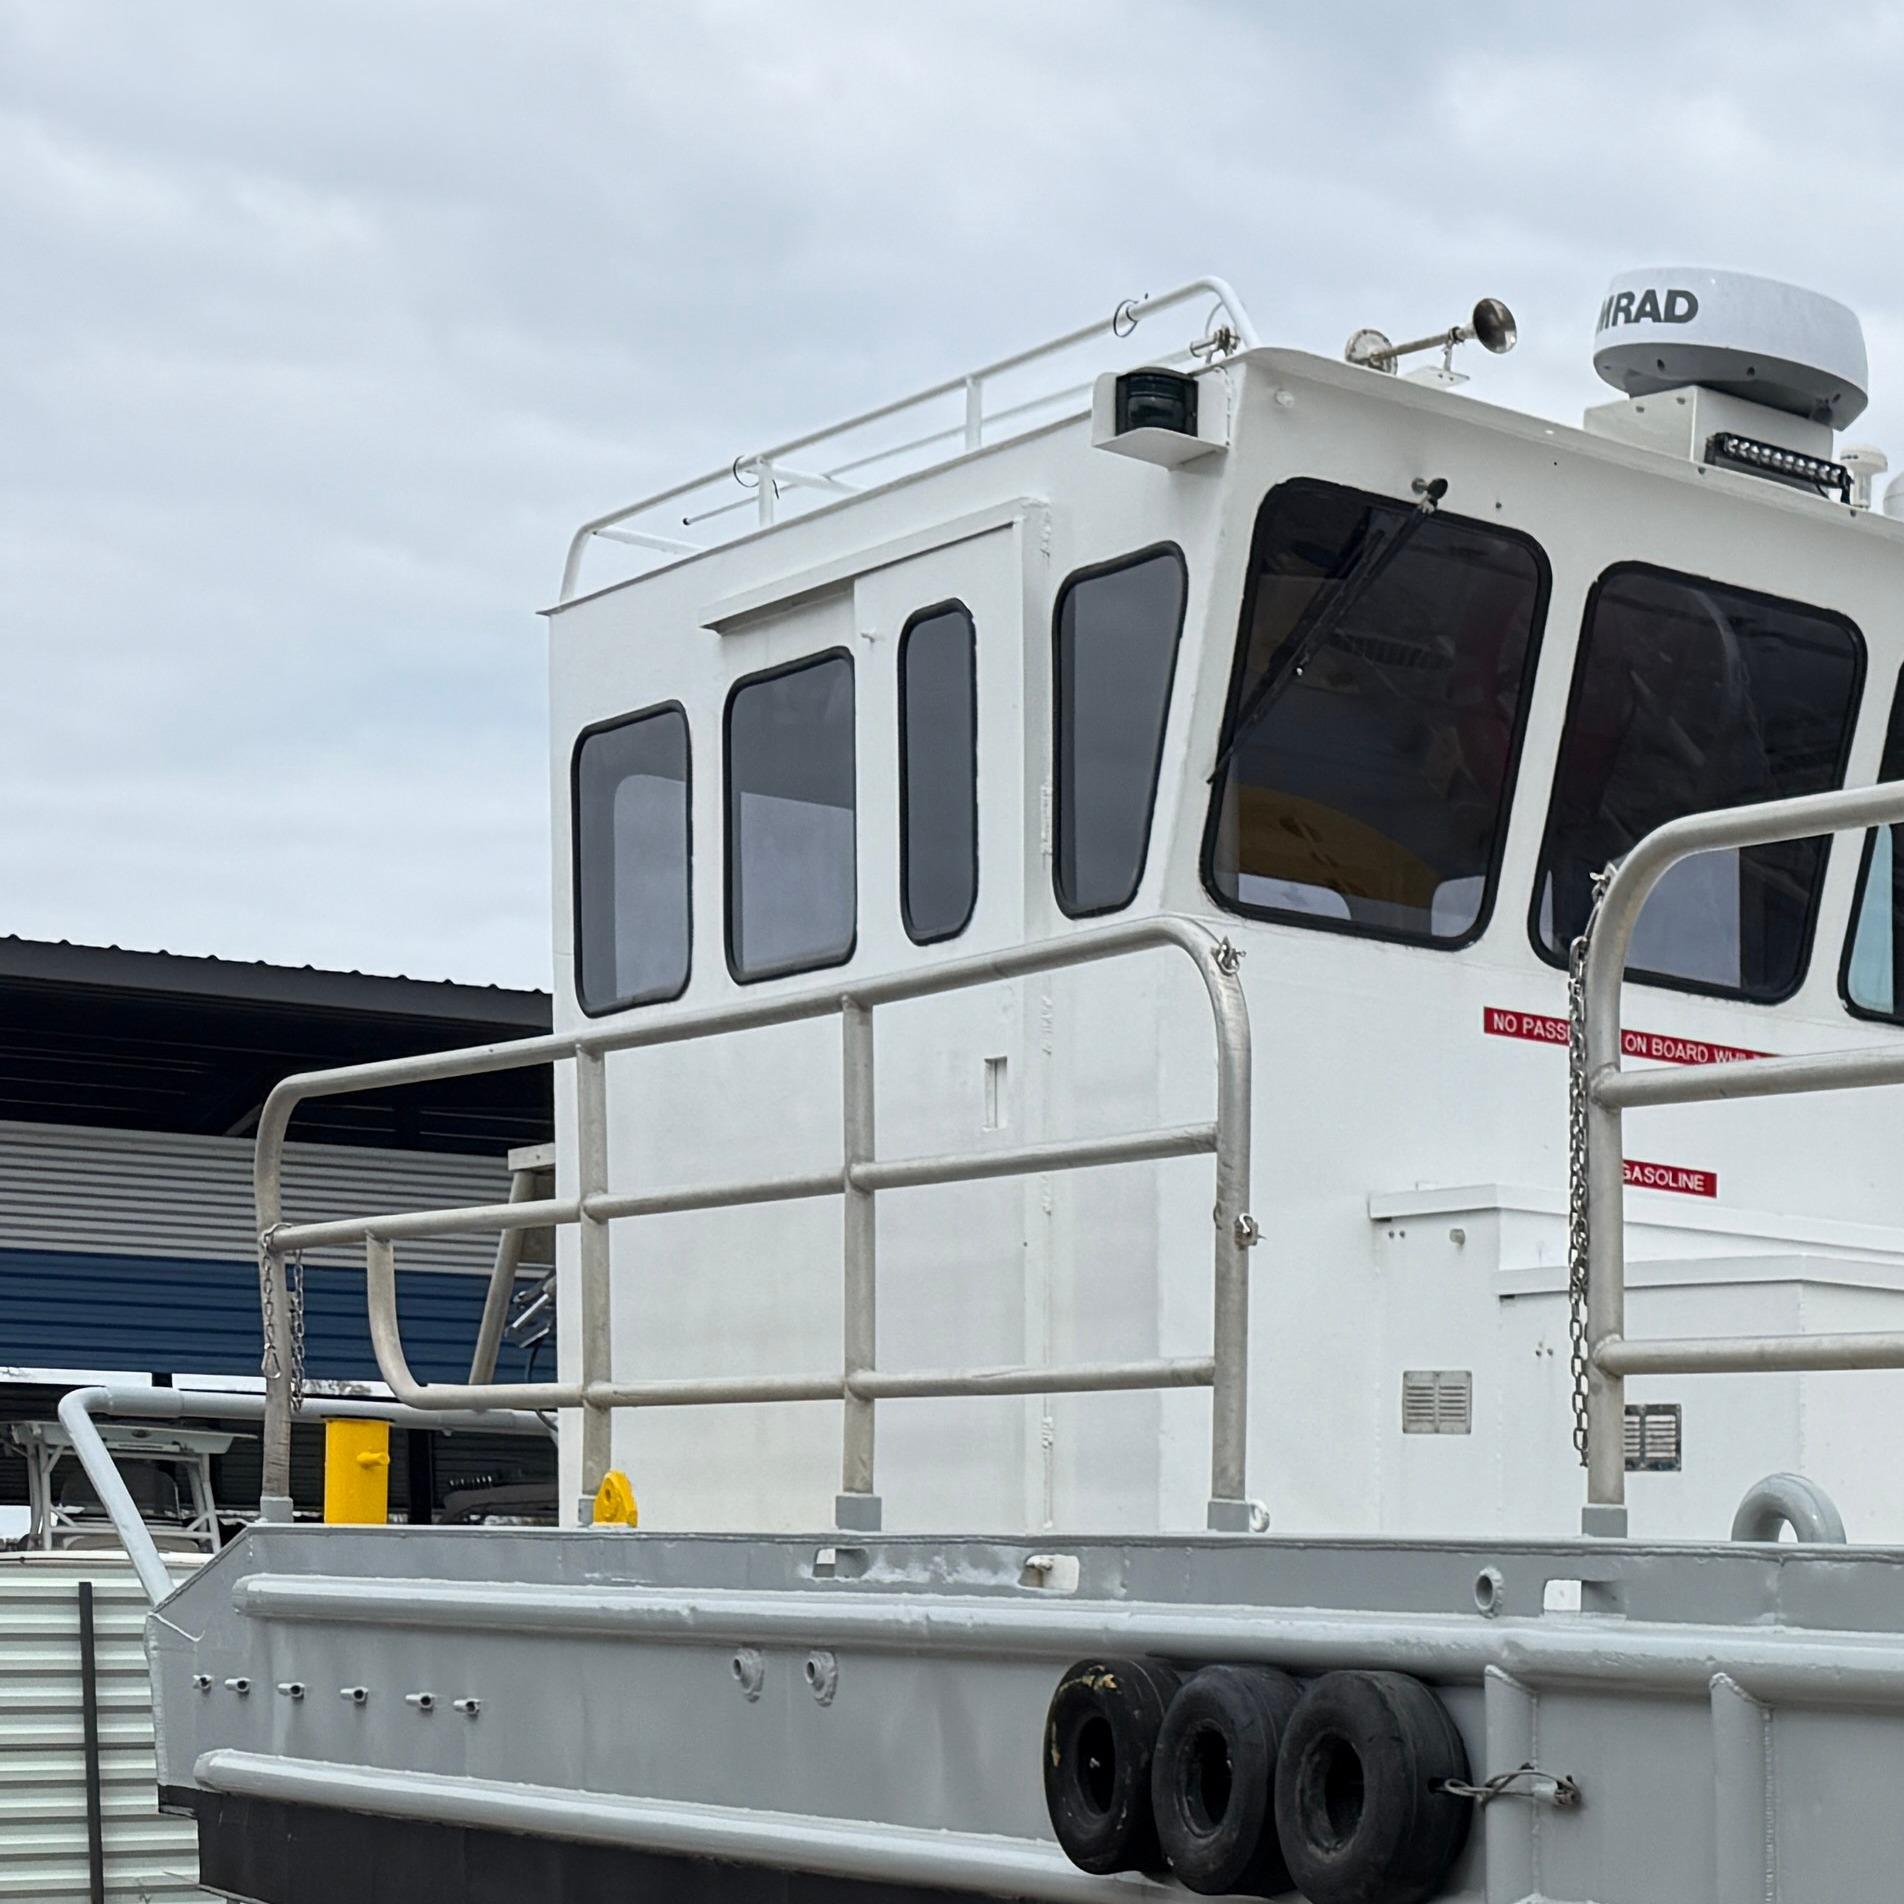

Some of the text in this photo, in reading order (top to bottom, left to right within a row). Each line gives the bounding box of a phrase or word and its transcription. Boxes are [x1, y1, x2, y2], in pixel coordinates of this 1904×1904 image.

[1493, 1012, 1517, 1033] NO
[1625, 1034, 1647, 1054] ON
[1652, 1038, 1709, 1063] BOARD
[1623, 1163, 1705, 1192] GASOLINE
